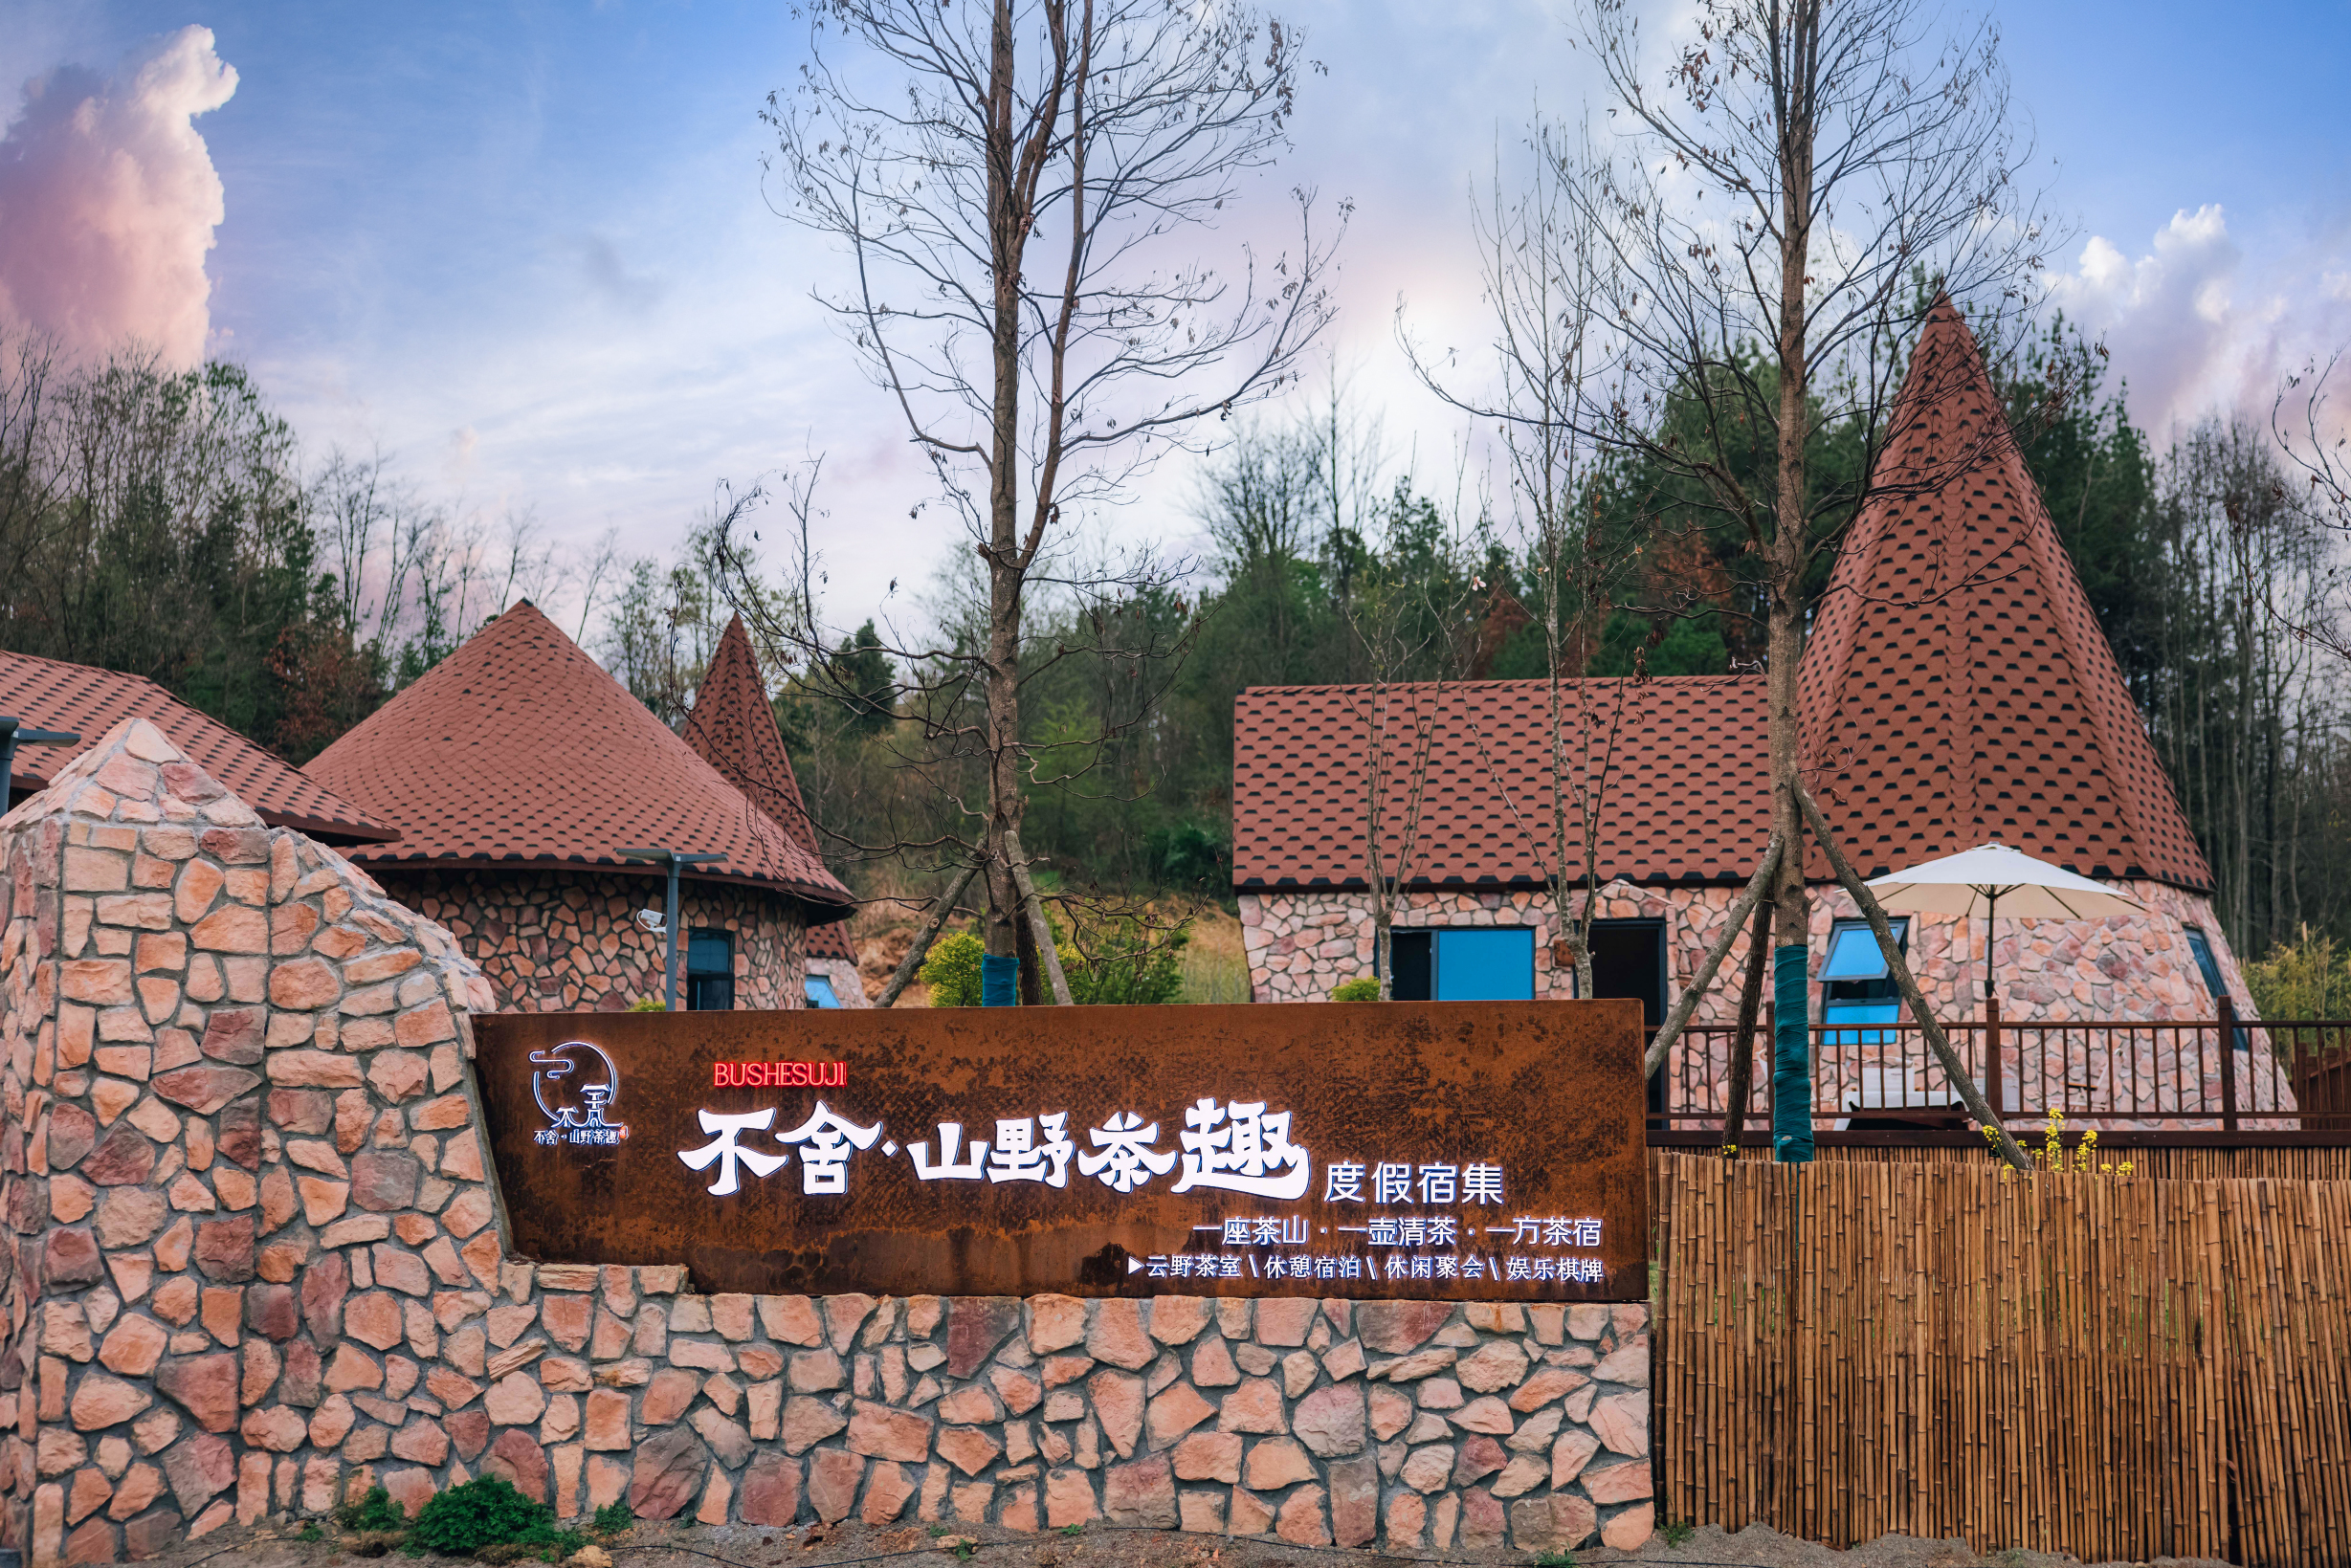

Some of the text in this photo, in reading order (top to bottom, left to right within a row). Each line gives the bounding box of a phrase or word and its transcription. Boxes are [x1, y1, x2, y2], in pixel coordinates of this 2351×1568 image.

[713, 1061, 848, 1088] BUSHESUJI
[1324, 1159, 1503, 1204] 度假宿集
